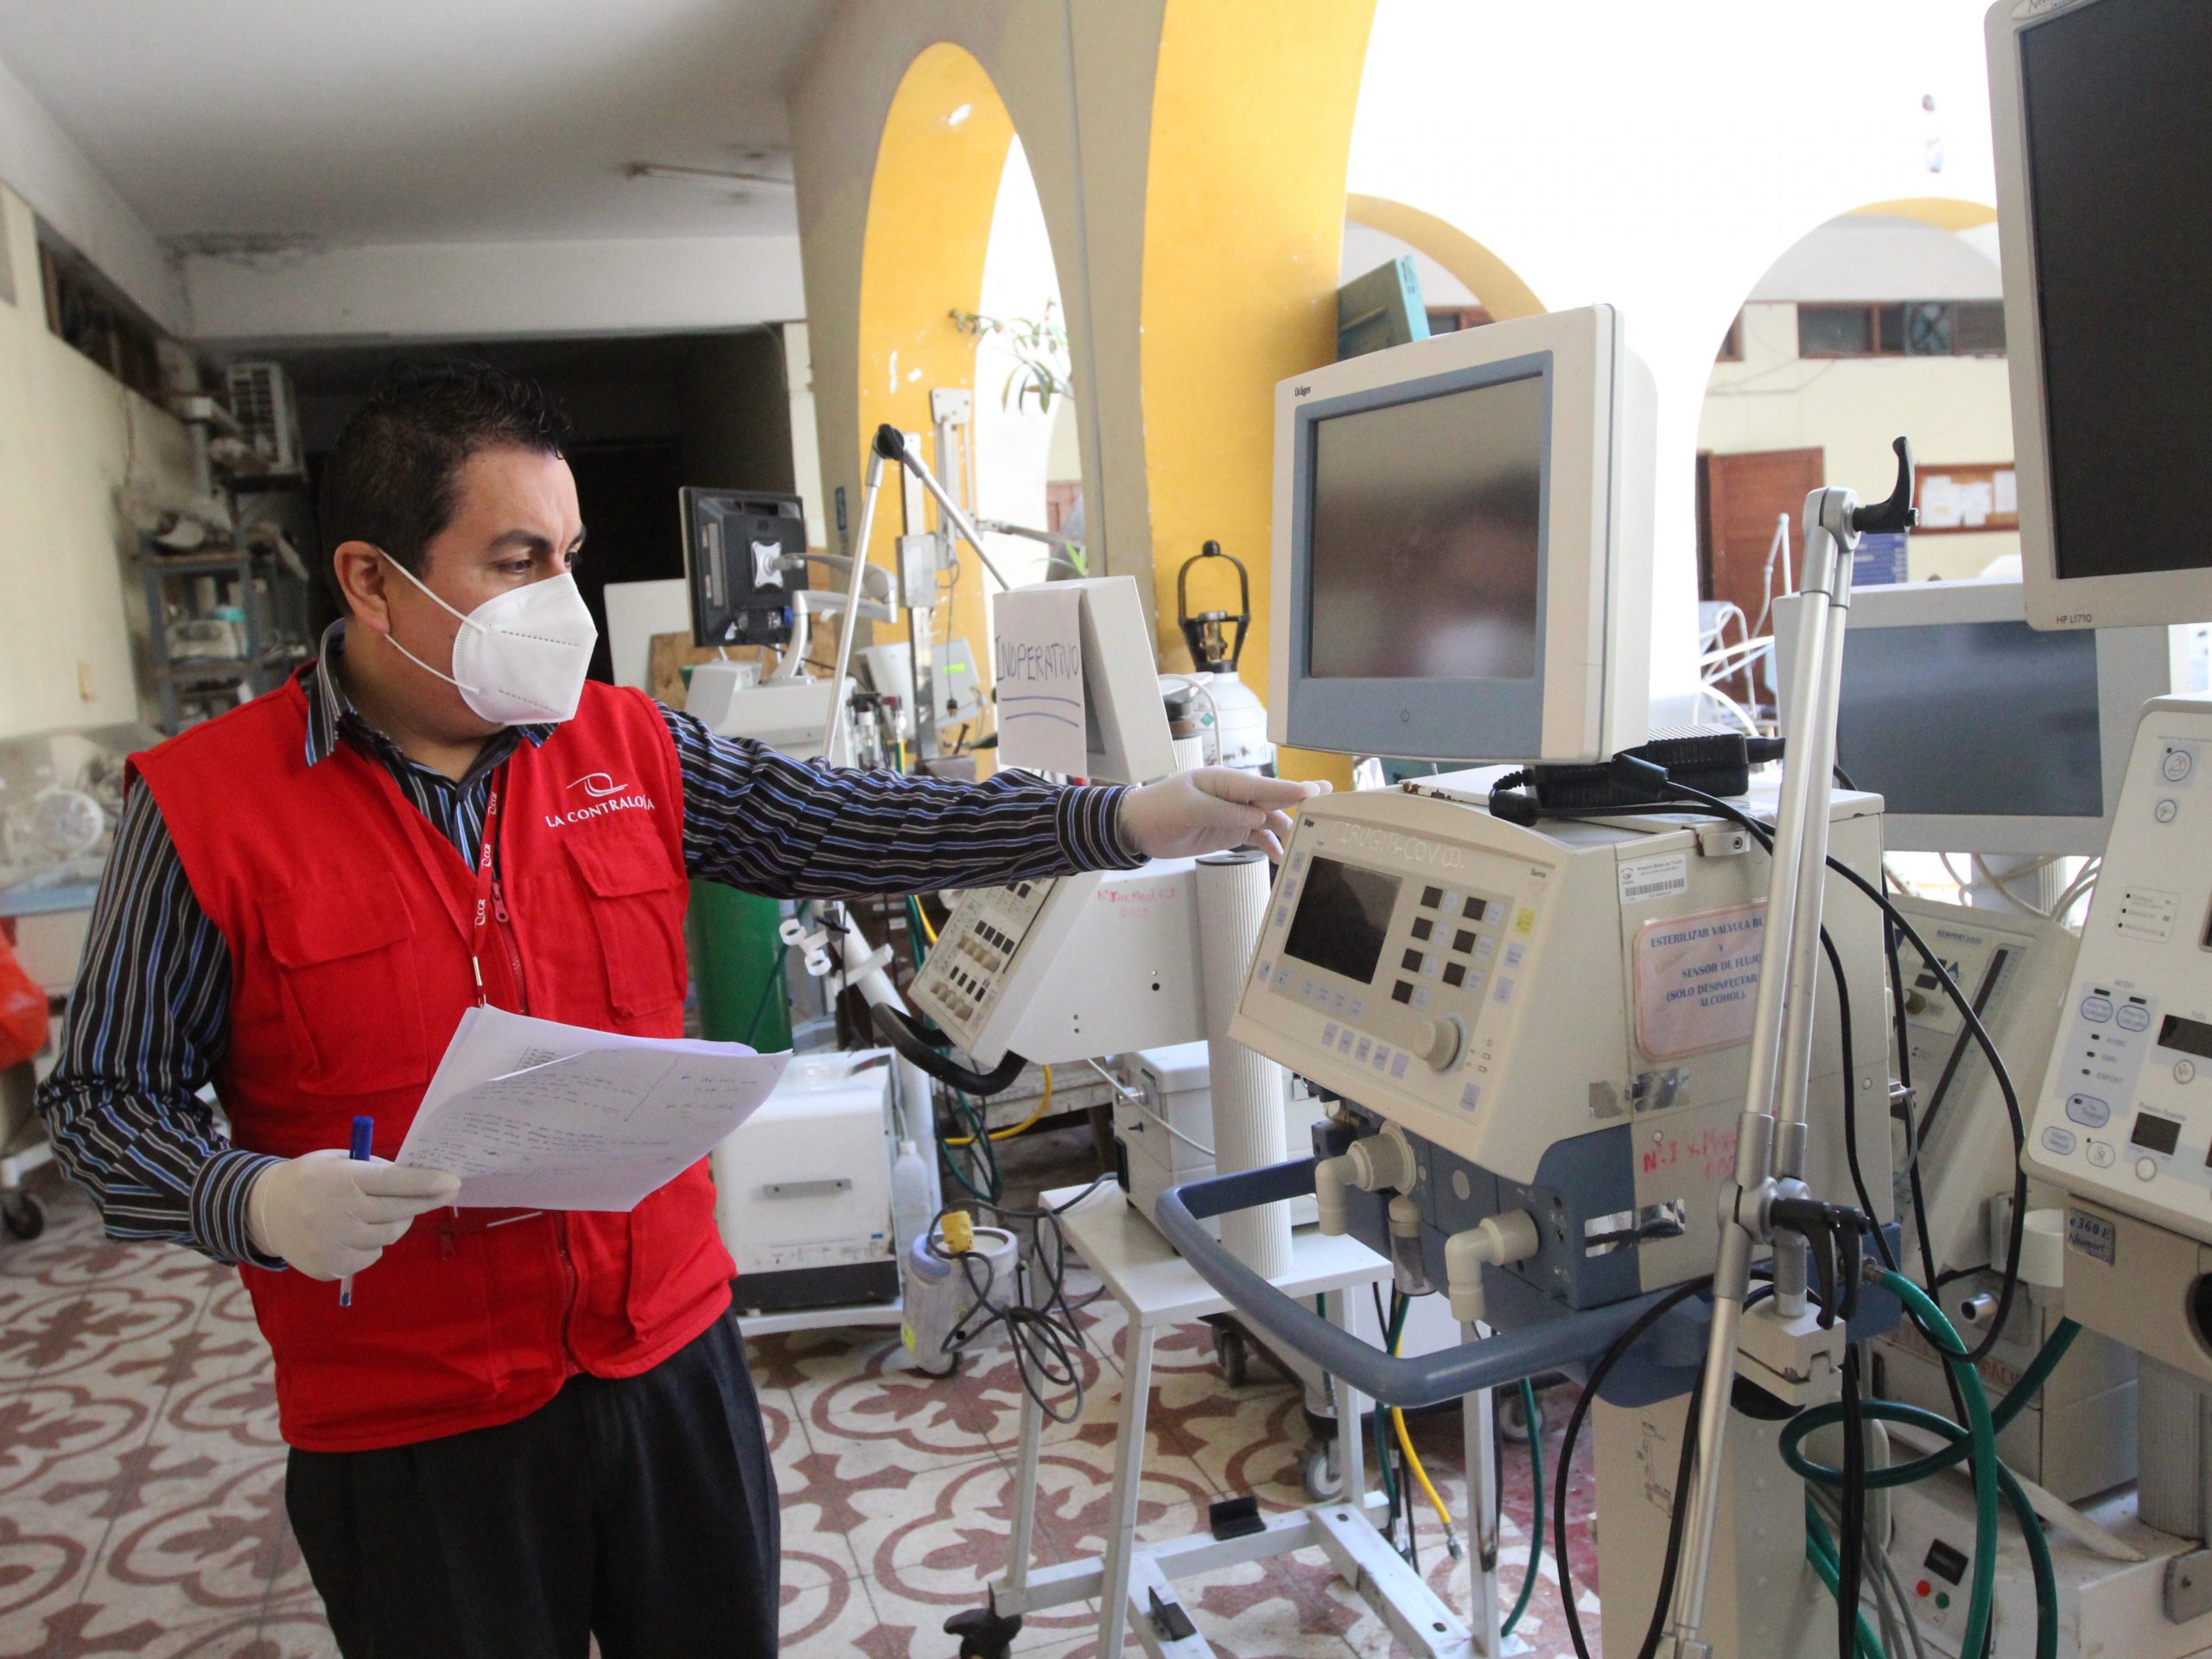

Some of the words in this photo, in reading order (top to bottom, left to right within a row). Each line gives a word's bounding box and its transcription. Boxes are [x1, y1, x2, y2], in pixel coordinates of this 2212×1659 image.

[2056, 615, 2068, 624] HP
[545, 815, 566, 828] LA
[1651, 927, 1709, 948] ESTERILIZAR
[1712, 919, 1751, 936] VALVULA
[1681, 962, 1718, 979] SENSOR
[1720, 959, 1732, 971] DE
[1735, 953, 1762, 967] FLUJO
[1698, 974, 1758, 995] DESINFECTAR
